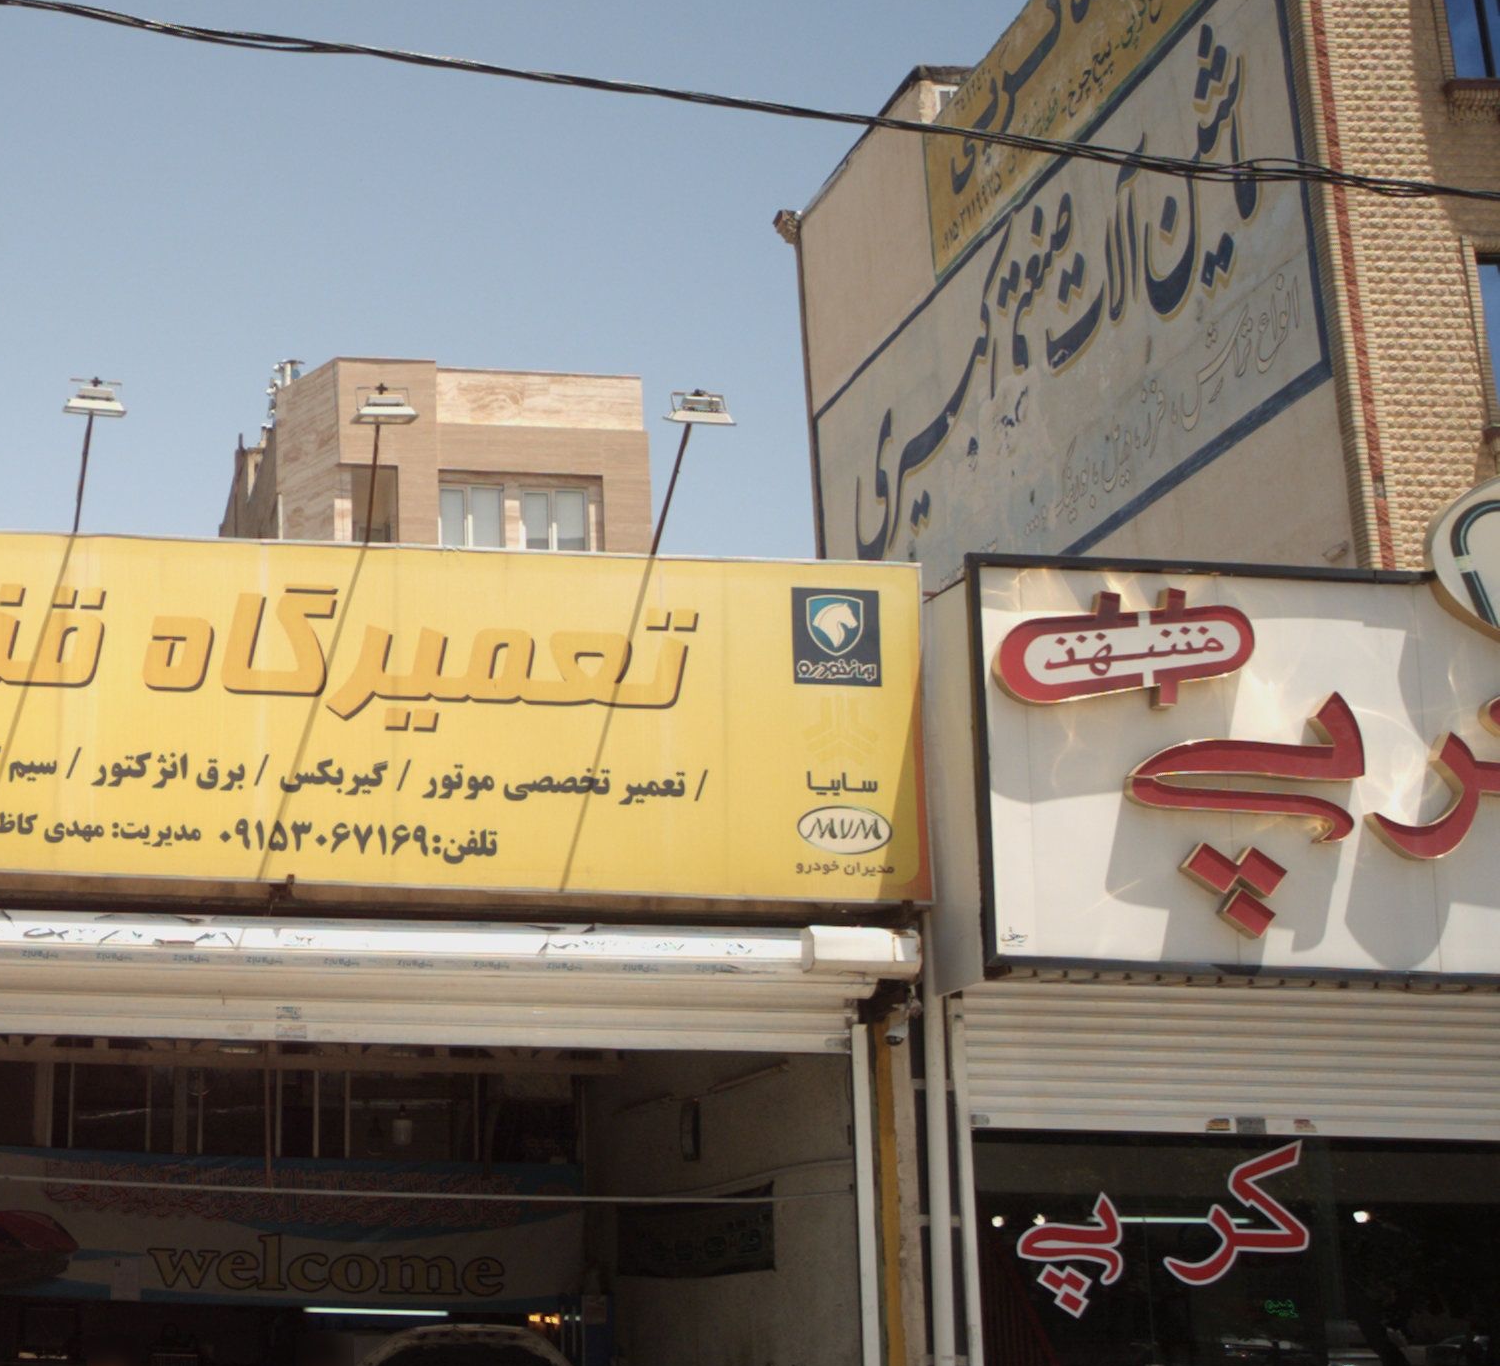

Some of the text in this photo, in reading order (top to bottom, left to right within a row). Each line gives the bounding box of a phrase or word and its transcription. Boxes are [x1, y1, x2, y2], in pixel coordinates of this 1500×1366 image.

[1256, 272, 1299, 374] انواع
[141, 583, 700, 733] تعمیرگاه
[8, 755, 58, 783] سیم
[90, 750, 189, 789] انژکتور
[195, 757, 246, 792] برق
[279, 756, 389, 797] گیربکس
[421, 762, 495, 800] موتور
[503, 768, 611, 802] تخصصی
[805, 770, 878, 796] سایپا
[617, 771, 687, 806] تعمیر
[43, 815, 105, 846] مهدی
[111, 816, 202, 849] مدیریت:
[806, 816, 883, 841] MVM
[795, 859, 895, 877] مدیران خودرو
[146, 1232, 506, 1299] welcome
